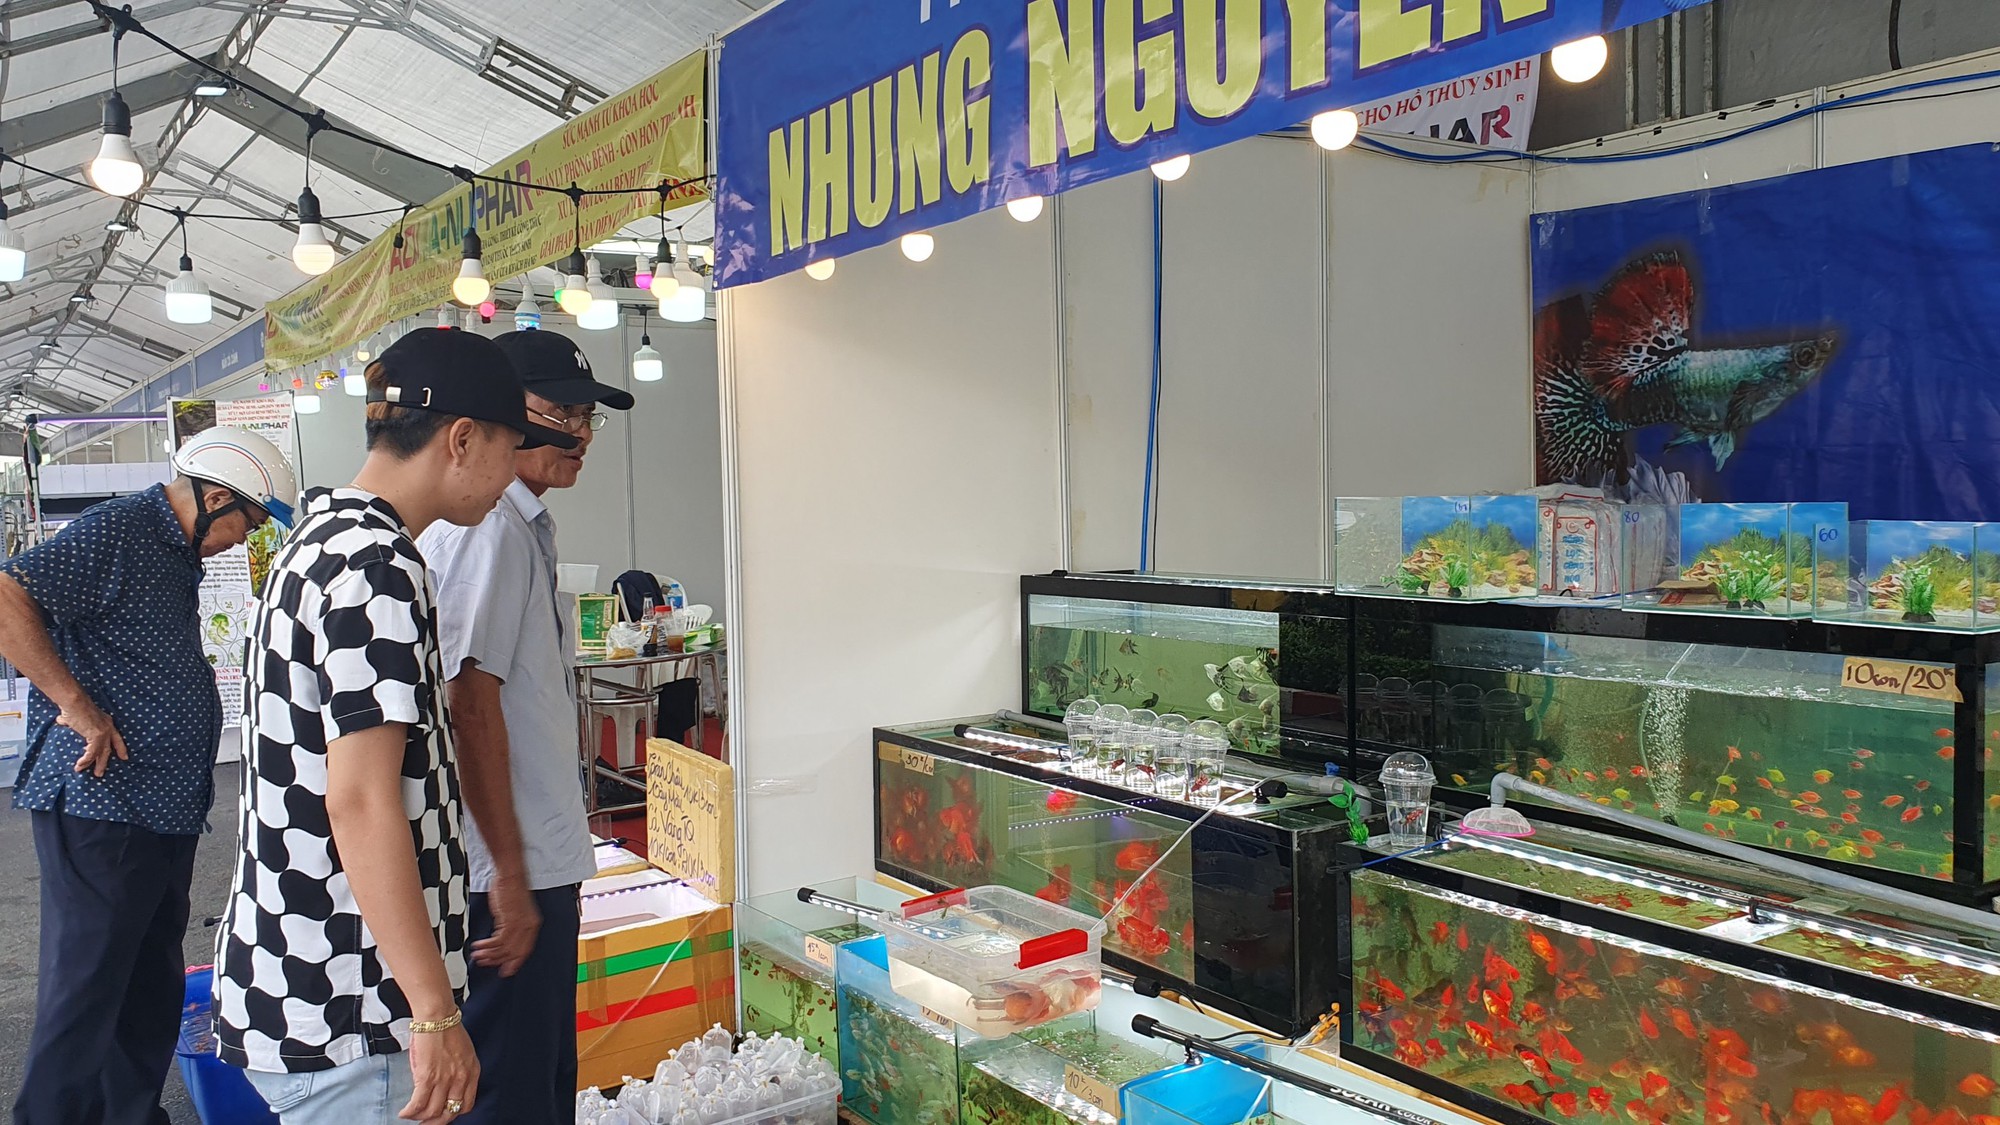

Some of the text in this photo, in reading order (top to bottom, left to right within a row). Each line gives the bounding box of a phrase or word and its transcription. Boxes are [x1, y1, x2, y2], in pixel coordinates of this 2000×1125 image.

[612, 93, 637, 122] KHOA
[639, 80, 659, 108] HỌC
[1395, 89, 1422, 117] HỒ
[769, 0, 1548, 257] NHUNG NGU
[1624, 511, 1640, 523] 80
[1818, 528, 1838, 542] 60
